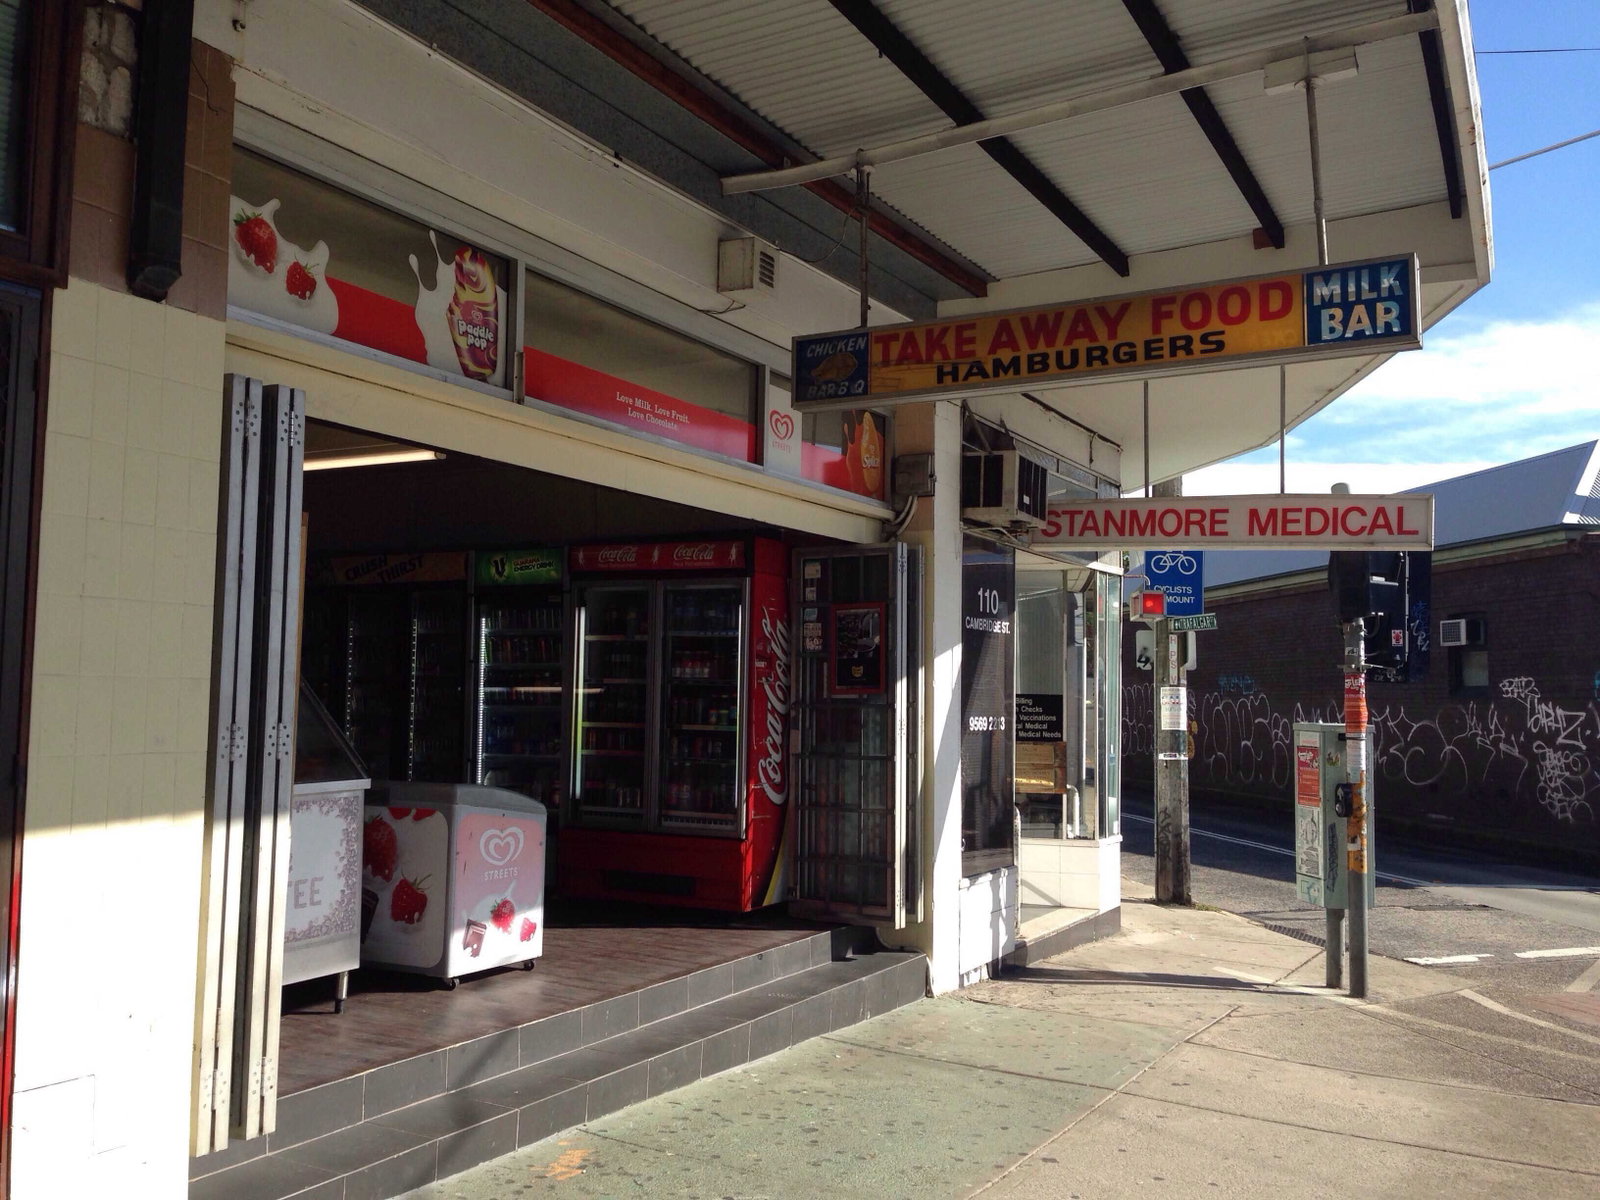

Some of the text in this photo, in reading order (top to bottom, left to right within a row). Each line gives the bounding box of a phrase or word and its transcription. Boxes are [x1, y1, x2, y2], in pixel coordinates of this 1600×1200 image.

[1312, 265, 1404, 306] MILK
[874, 280, 1294, 366] TAKE AWAY FOOD
[1320, 301, 1402, 341] BAR
[806, 336, 867, 358] CHICKEN
[936, 330, 1226, 385] HAMBURGERS
[616, 391, 633, 405] Love
[654, 404, 670, 417] Love
[628, 407, 645, 420] Love
[1040, 506, 1420, 538] STANMORE MEDICAL
[345, 552, 388, 581] CRUSH
[377, 555, 424, 583] THIRST
[977, 587, 999, 615] 110
[1153, 584, 1193, 594] CYCLISTS
[1165, 595, 1195, 604] MOUNT
[965, 616, 1011, 634] CAMBRIDGE ST.
[758, 606, 791, 806] Coca-Cola
[1021, 705, 1043, 713] Checks
[969, 716, 988, 731] 9569
[1018, 730, 1041, 738] Medical
[483, 866, 519, 881] STREETS
